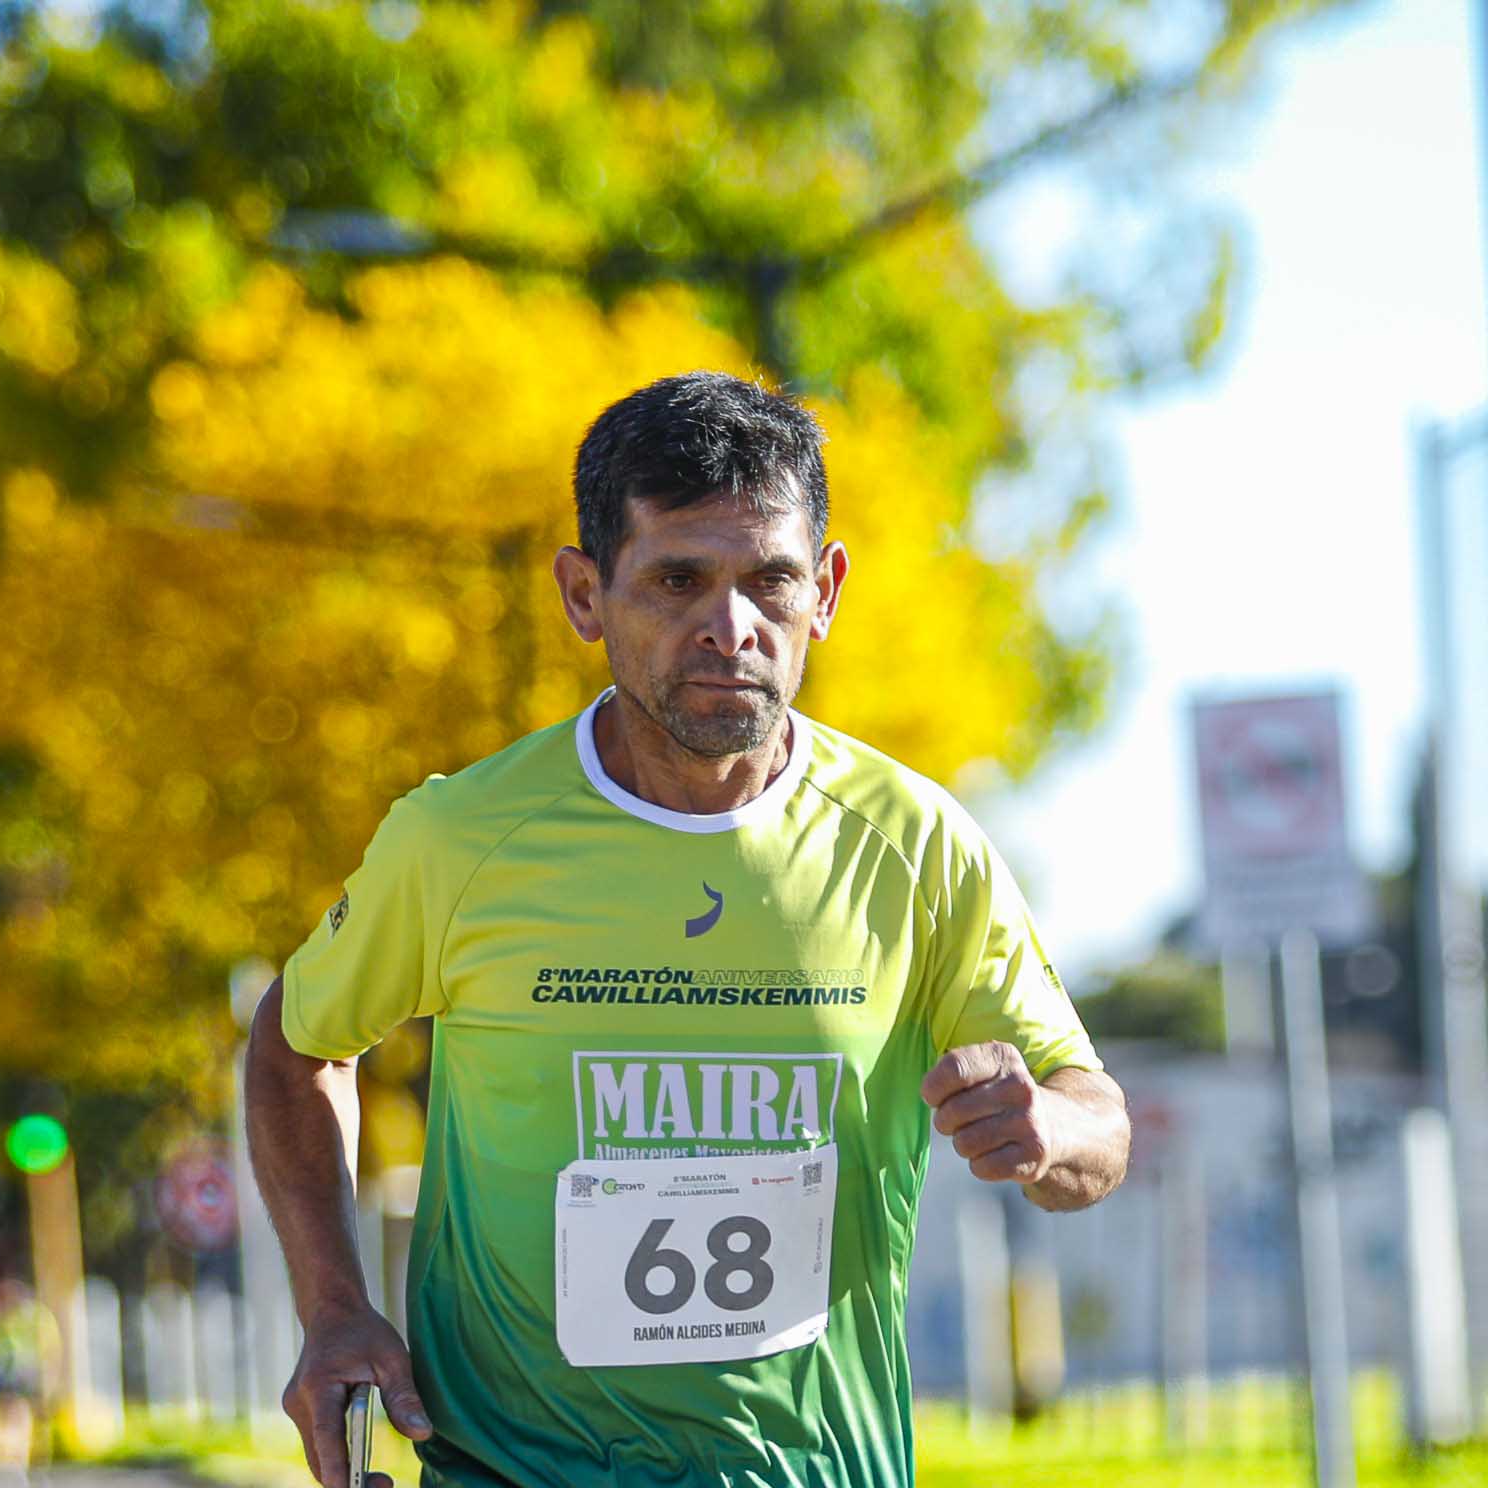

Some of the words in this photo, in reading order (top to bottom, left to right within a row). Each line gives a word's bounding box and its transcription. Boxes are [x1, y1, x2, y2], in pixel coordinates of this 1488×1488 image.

[531, 985, 867, 1005] CAWILLIAMSKEMMIS
[589, 1063, 821, 1140] MAIRA
[624, 1215, 774, 1315] 68
[633, 1324, 674, 1341] RAMÓN
[677, 1324, 722, 1340] ALCIDES
[725, 1319, 766, 1337] MEDINA
